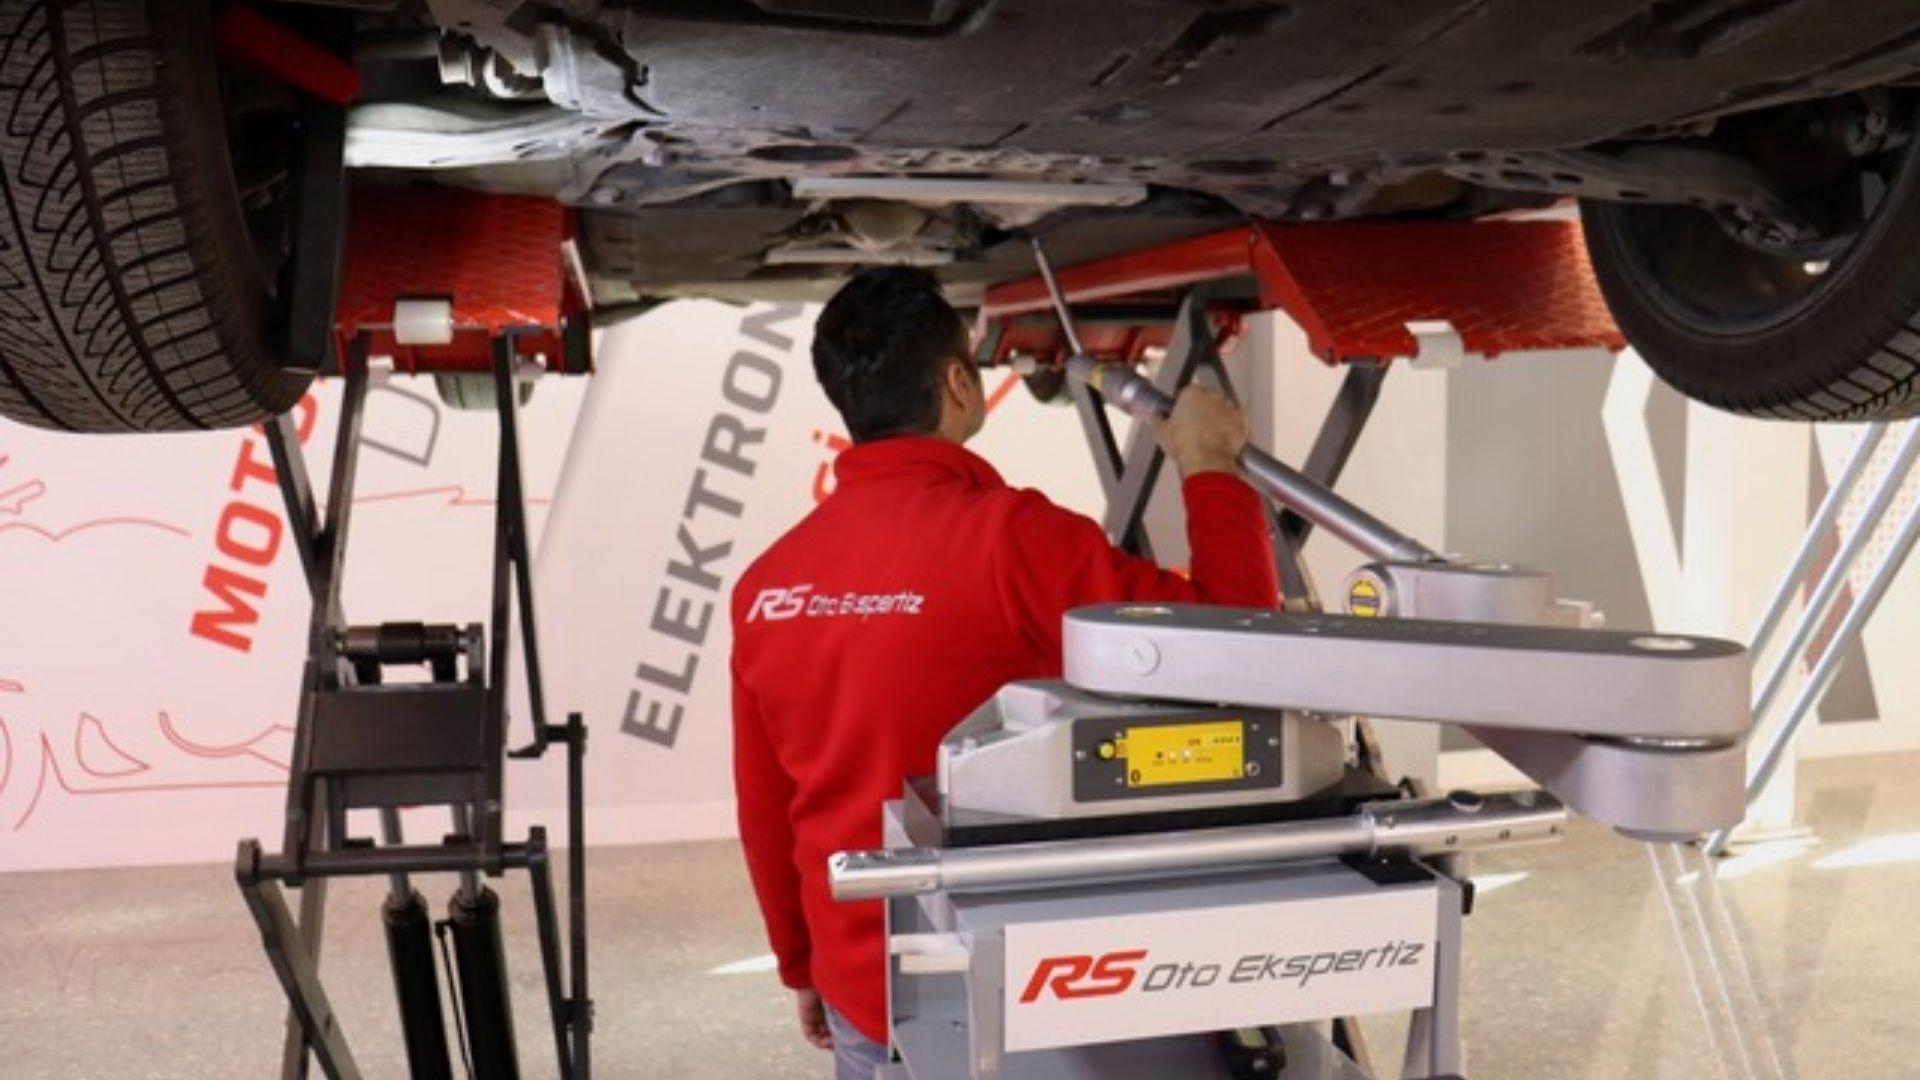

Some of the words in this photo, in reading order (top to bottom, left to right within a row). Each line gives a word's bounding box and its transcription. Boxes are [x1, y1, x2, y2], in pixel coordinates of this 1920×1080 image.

[745, 583, 814, 623] RS
[1018, 949, 1149, 1004] RS
[1142, 963, 1220, 992] Oto
[1228, 939, 1425, 988] Ekspertiz
